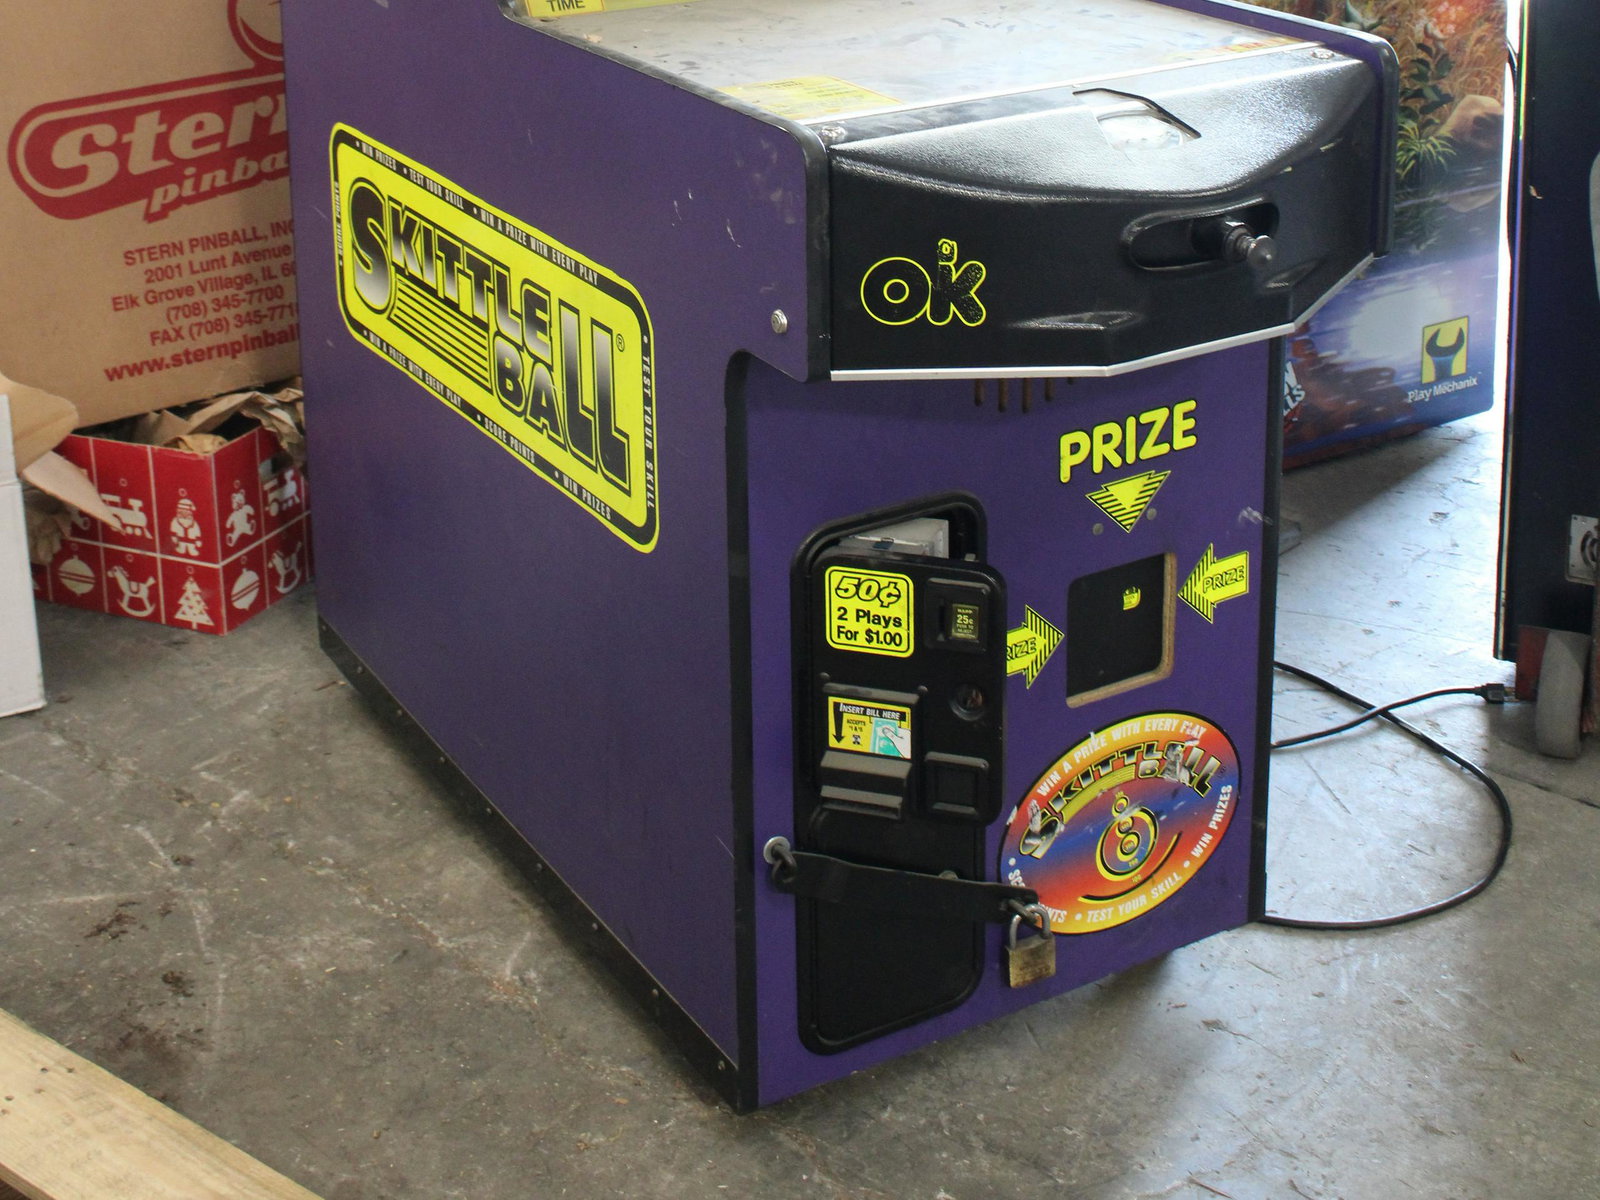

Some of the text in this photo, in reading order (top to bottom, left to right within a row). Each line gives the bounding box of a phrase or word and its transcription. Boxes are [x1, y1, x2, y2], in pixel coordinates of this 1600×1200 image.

[149, 152, 288, 215] pinba
[123, 240, 185, 267] STERN
[188, 226, 268, 254] PINBALL,
[409, 168, 424, 187] TEST
[480, 208, 495, 228] WIN
[505, 222, 528, 246] PRIZE
[530, 236, 548, 258] WITH
[552, 248, 577, 273] EVERY
[579, 263, 599, 286] PLAY
[144, 244, 292, 285] 2001 Lunt Avenue
[349, 176, 553, 362] SKITTLE
[112, 293, 141, 312] Elk
[144, 284, 195, 306] Grove
[197, 271, 259, 295] Village,
[262, 265, 278, 282] IL
[166, 284, 285, 326] (708) 345-7700
[149, 302, 298, 347] FAX (708) 345-771
[494, 298, 631, 495] BALL
[1408, 376, 1478, 403] Play Mechanix
[642, 355, 656, 509] TEST YOUR SKILL
[1059, 399, 1197, 484] PRIZE
[484, 417, 507, 443] SCORE
[510, 434, 535, 464] POINTS
[562, 473, 578, 495] WIN
[582, 488, 611, 520] PRIZES
[835, 575, 902, 608] 50¢
[1202, 564, 1245, 594] PRIZE
[836, 606, 903, 629] 2 Plays
[836, 625, 903, 647] For $1.00
[1006, 637, 1037, 662] RIZE
[839, 702, 901, 720] INSERT BILL HERE
[1036, 773, 1061, 797] WIN
[1063, 762, 1073, 774] A
[1111, 720, 1141, 741] WITH
[1144, 717, 1178, 733] EVERY
[1191, 784, 1233, 859] WIN PRIZES
[1086, 907, 1114, 924] TEST
[1118, 895, 1148, 917] YOUR
[1150, 872, 1182, 900] SKILL
